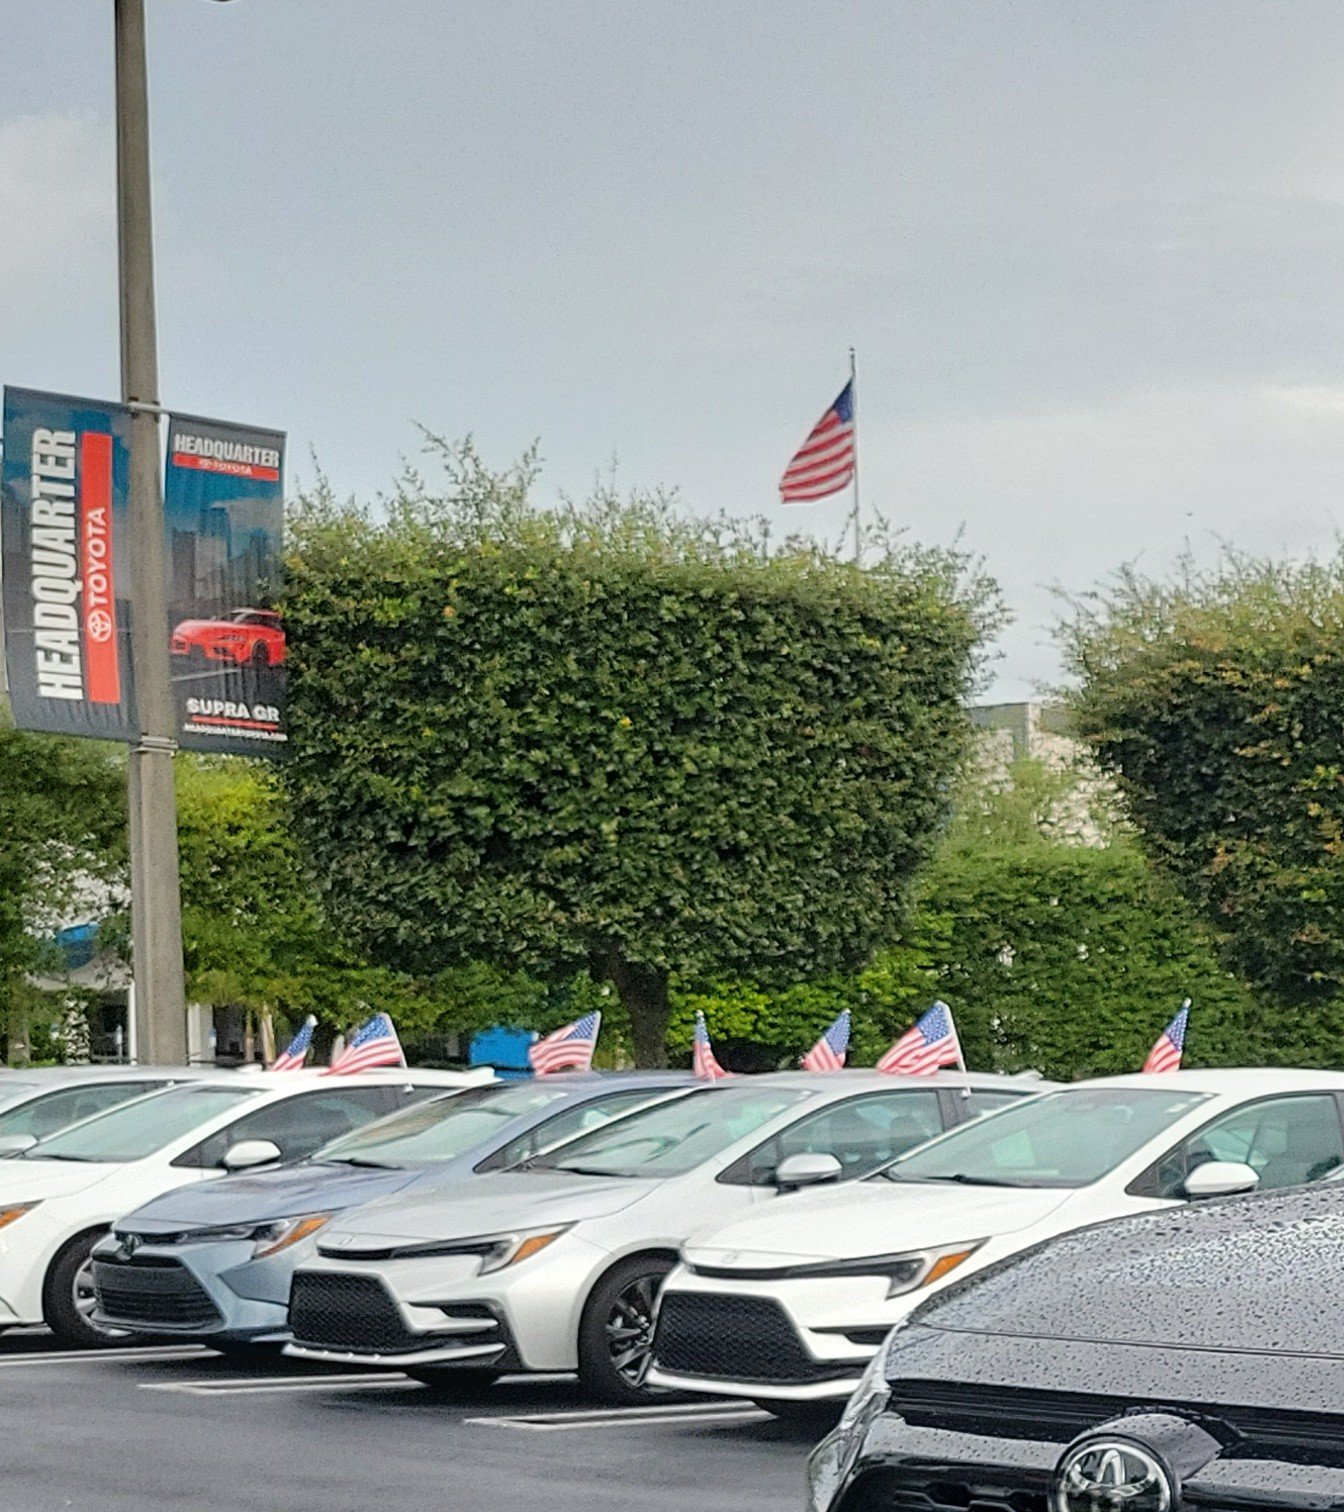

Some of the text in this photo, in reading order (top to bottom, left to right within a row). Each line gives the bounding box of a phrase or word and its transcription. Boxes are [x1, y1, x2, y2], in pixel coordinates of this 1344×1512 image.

[174, 434, 279, 468] HEADQUARTER
[32, 428, 83, 700] HEADQUARTER
[87, 507, 108, 607] TOYOTA
[186, 698, 279, 721] SUPRA GR
